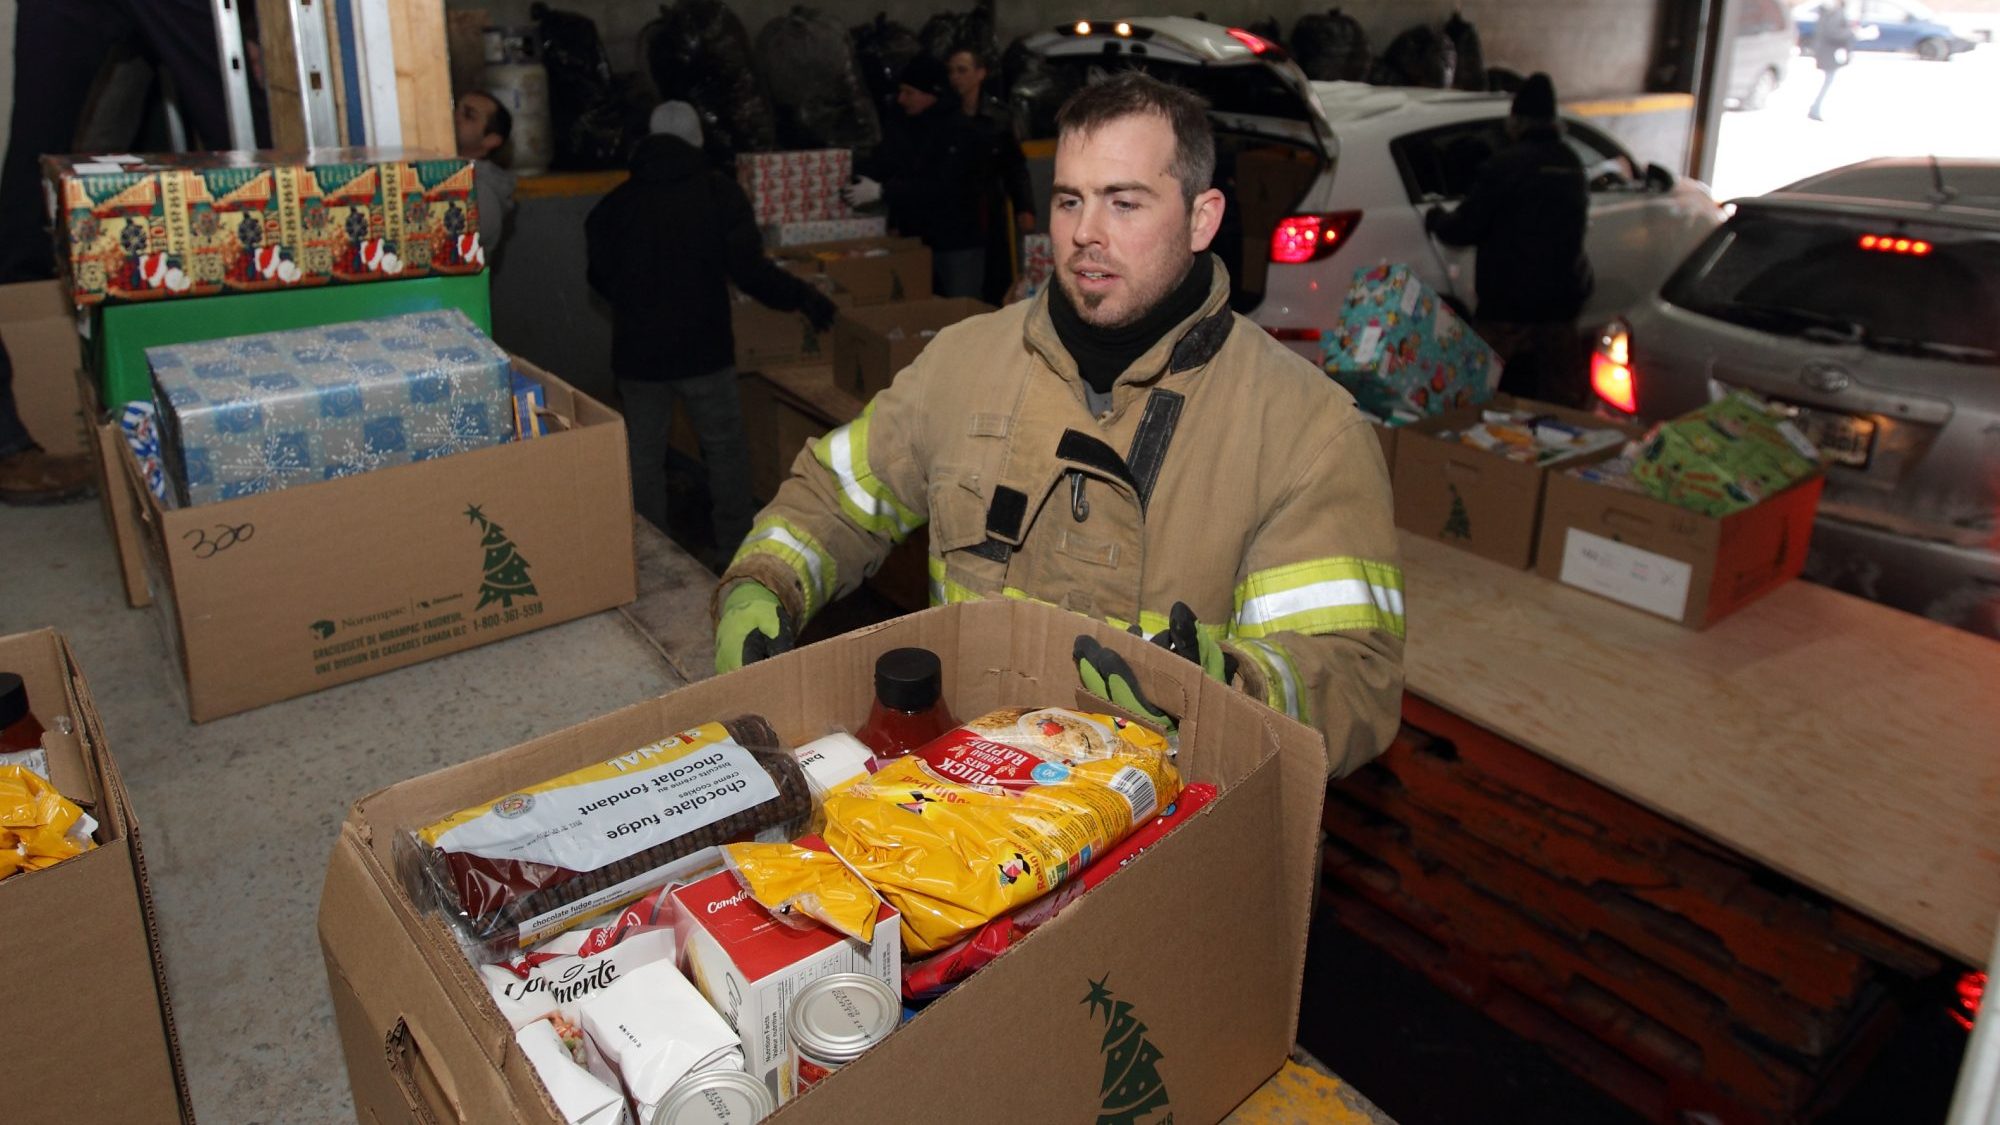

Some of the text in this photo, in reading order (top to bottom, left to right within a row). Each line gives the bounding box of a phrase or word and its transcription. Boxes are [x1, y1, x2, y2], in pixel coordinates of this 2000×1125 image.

[182, 522, 255, 559] 320
[341, 604, 405, 630] Norampac
[315, 662, 332, 675] UNE
[334, 652, 369, 670] DIVISION
[370, 648, 381, 660] DE
[382, 638, 421, 657] CASCADES
[422, 630, 451, 648] CANADA
[366, 633, 377, 645] DE
[963, 757, 990, 771] OATS
[967, 739, 1029, 767] RAPIDE
[969, 749, 1004, 765] GRUAU
[698, 761, 733, 778] biscuits
[936, 757, 998, 785] QUICK
[578, 752, 724, 816] chocolat fondant
[657, 785, 669, 793] au
[678, 771, 740, 799] creme cookies
[664, 779, 747, 818] chocolate
[606, 813, 661, 840] fudge
[1029, 855, 1047, 891] Robin
[532, 908, 569, 928] chocolate
[570, 900, 592, 914] fudge
[707, 888, 749, 914] Compli
